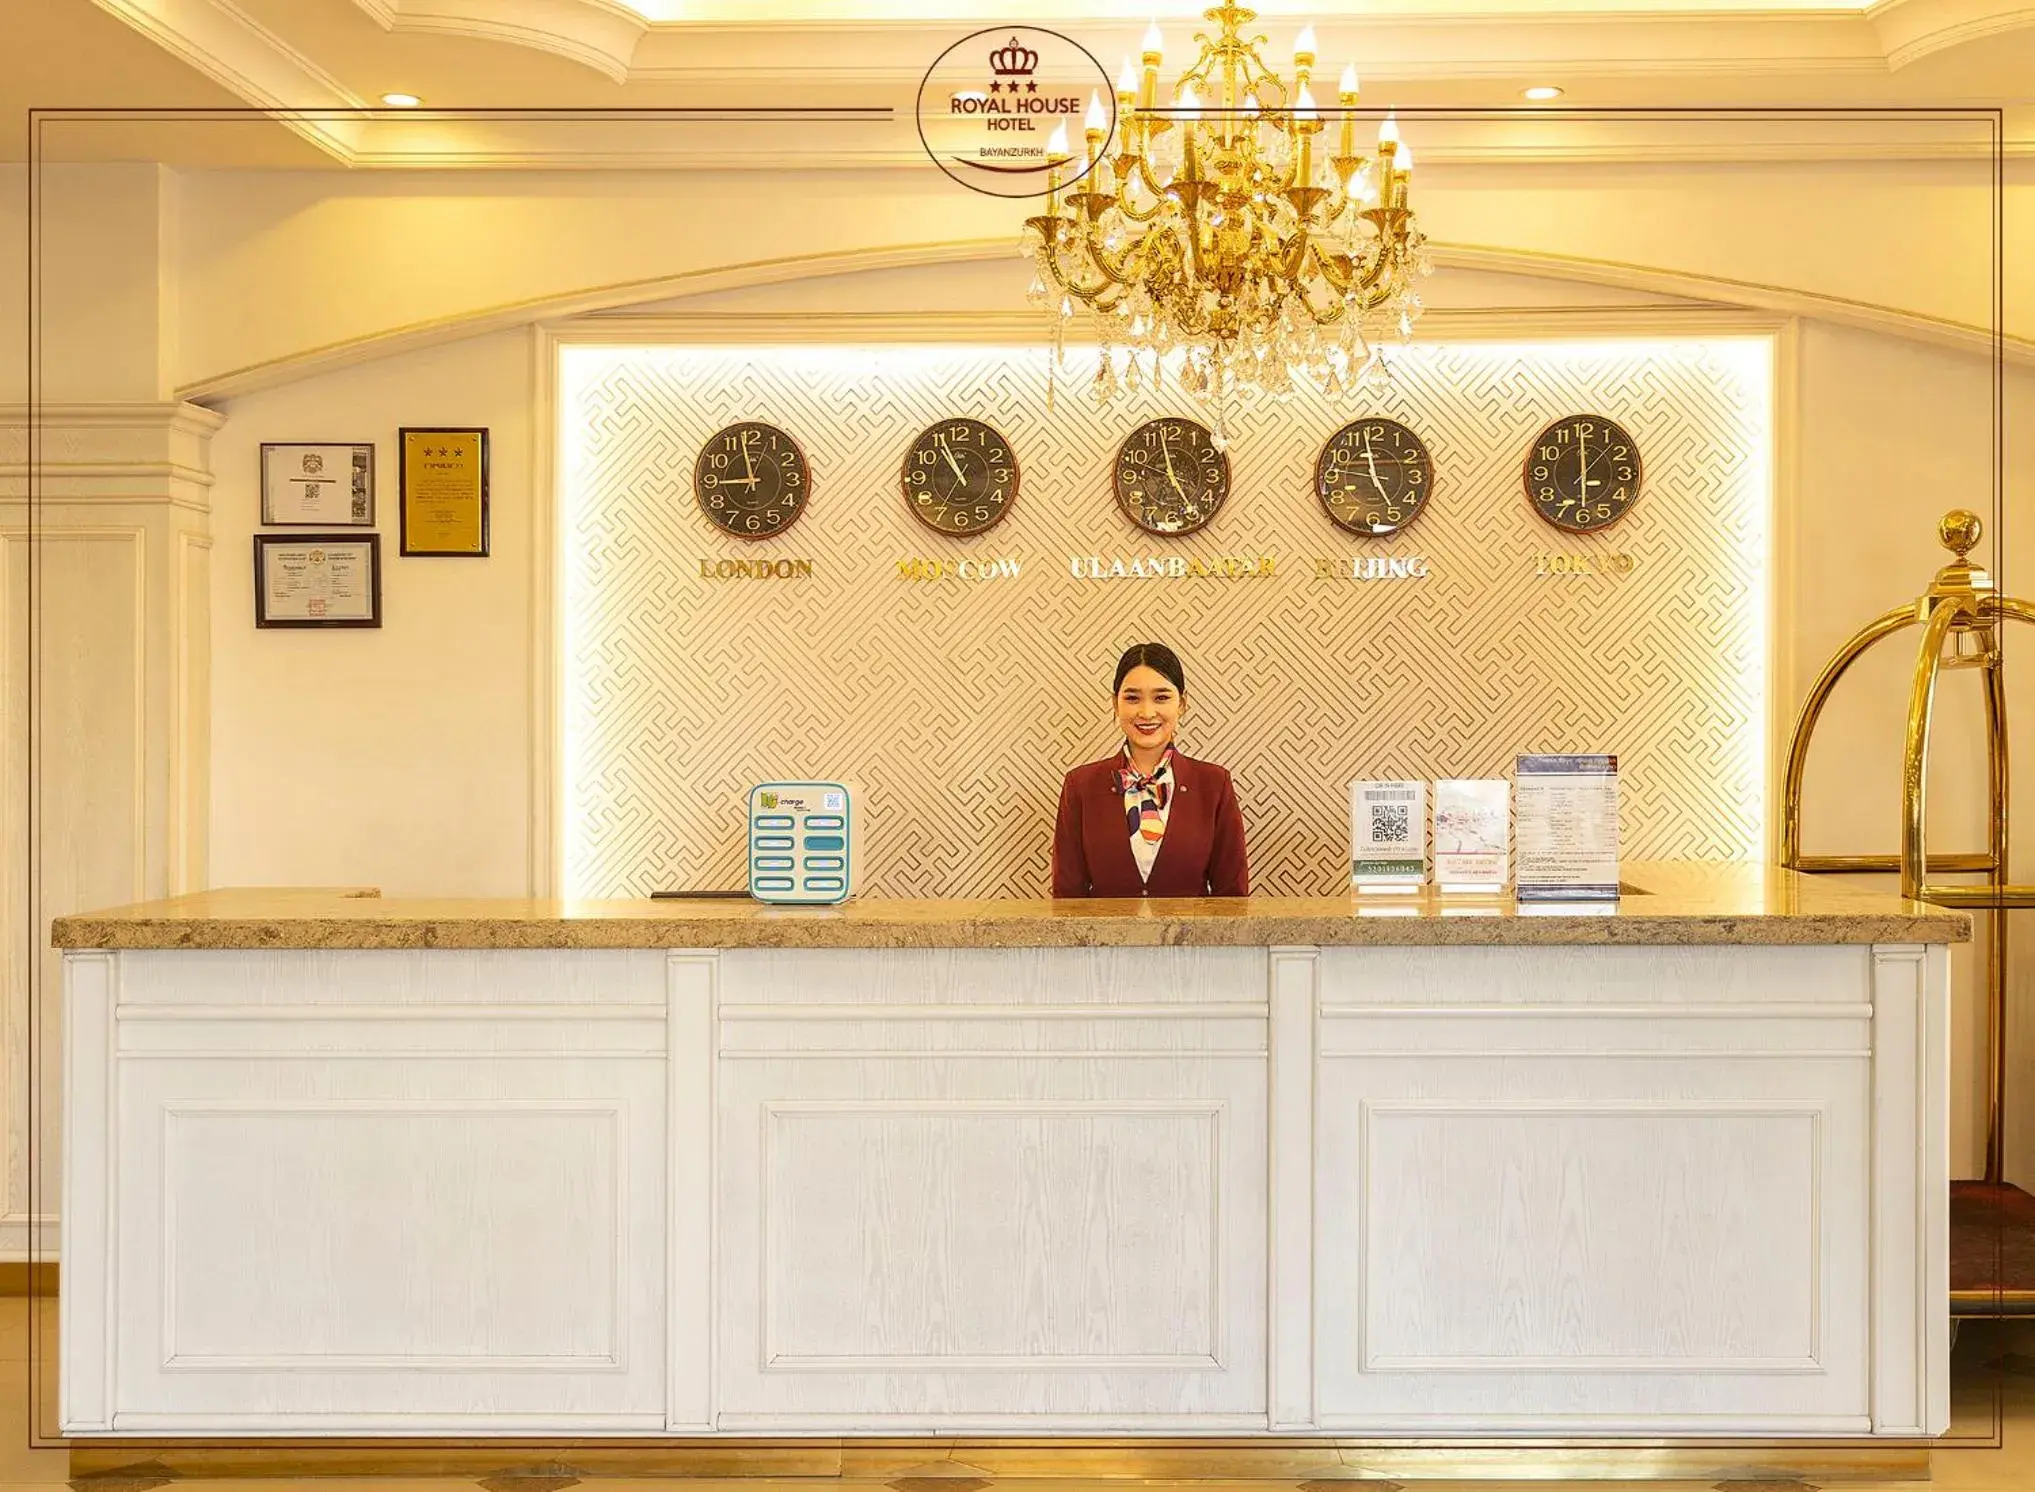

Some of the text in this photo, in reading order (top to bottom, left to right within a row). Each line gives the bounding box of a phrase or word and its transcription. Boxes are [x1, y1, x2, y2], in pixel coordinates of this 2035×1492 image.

[742, 430, 761, 445] 12
[949, 426, 970, 441] 12
[1161, 426, 1181, 441] 12
[1364, 426, 1384, 441] 12
[1555, 429, 1569, 443] 11
[1573, 423, 1594, 438] 12
[1602, 429, 1609, 443] 1
[724, 435, 737, 451] 11
[770, 435, 777, 450] 1
[932, 432, 945, 447] 11
[978, 431, 985, 446] 1
[1144, 432, 1156, 447] 11
[1190, 431, 1196, 446] 1
[1346, 432, 1360, 447] 11
[1393, 432, 1400, 447] 1
[706, 453, 728, 468] 10
[781, 452, 795, 466] 2
[917, 450, 937, 465] 10
[989, 448, 1003, 463] 2
[1128, 450, 1148, 464] 10
[1201, 448, 1214, 463] 2
[1330, 449, 1350, 464] 10
[1404, 449, 1418, 464] 2
[1540, 446, 1559, 461] 10
[1613, 446, 1627, 461] 2
[786, 472, 800, 487] 3
[912, 470, 926, 485] 9
[994, 468, 1008, 483] 3
[1123, 470, 1137, 484] 9
[1205, 468, 1219, 483] 3
[1324, 469, 1339, 484] 9
[1408, 470, 1422, 484] 3
[1534, 466, 1548, 481] 9
[1618, 466, 1632, 481] 3
[703, 474, 718, 489] 9
[710, 494, 724, 509] 8
[781, 493, 795, 507] 4
[918, 491, 932, 505] 8
[990, 489, 1004, 503] 4
[1129, 491, 1143, 505] 8
[1201, 489, 1215, 505] 4
[1330, 490, 1345, 504] 8
[1403, 490, 1417, 505] 4
[1540, 487, 1554, 501] 8
[1612, 487, 1627, 501] 4
[726, 511, 739, 525] 7
[766, 510, 780, 524] 5
[935, 507, 948, 521] 7
[975, 505, 989, 520] 5
[1346, 507, 1359, 521] 7
[1387, 507, 1401, 522] 5
[1556, 503, 1571, 518] 7
[1576, 509, 1590, 523] 6
[1597, 504, 1611, 518] 5
[746, 515, 760, 530] 6
[954, 511, 968, 526] 6
[1366, 512, 1380, 527] 6
[699, 558, 812, 579] LONDON
[896, 557, 1022, 580] MOSCOW
[1069, 556, 1276, 578] ULAANBAATAR
[1316, 556, 1429, 578] BEIJING
[1531, 551, 1635, 575] TOKYO
